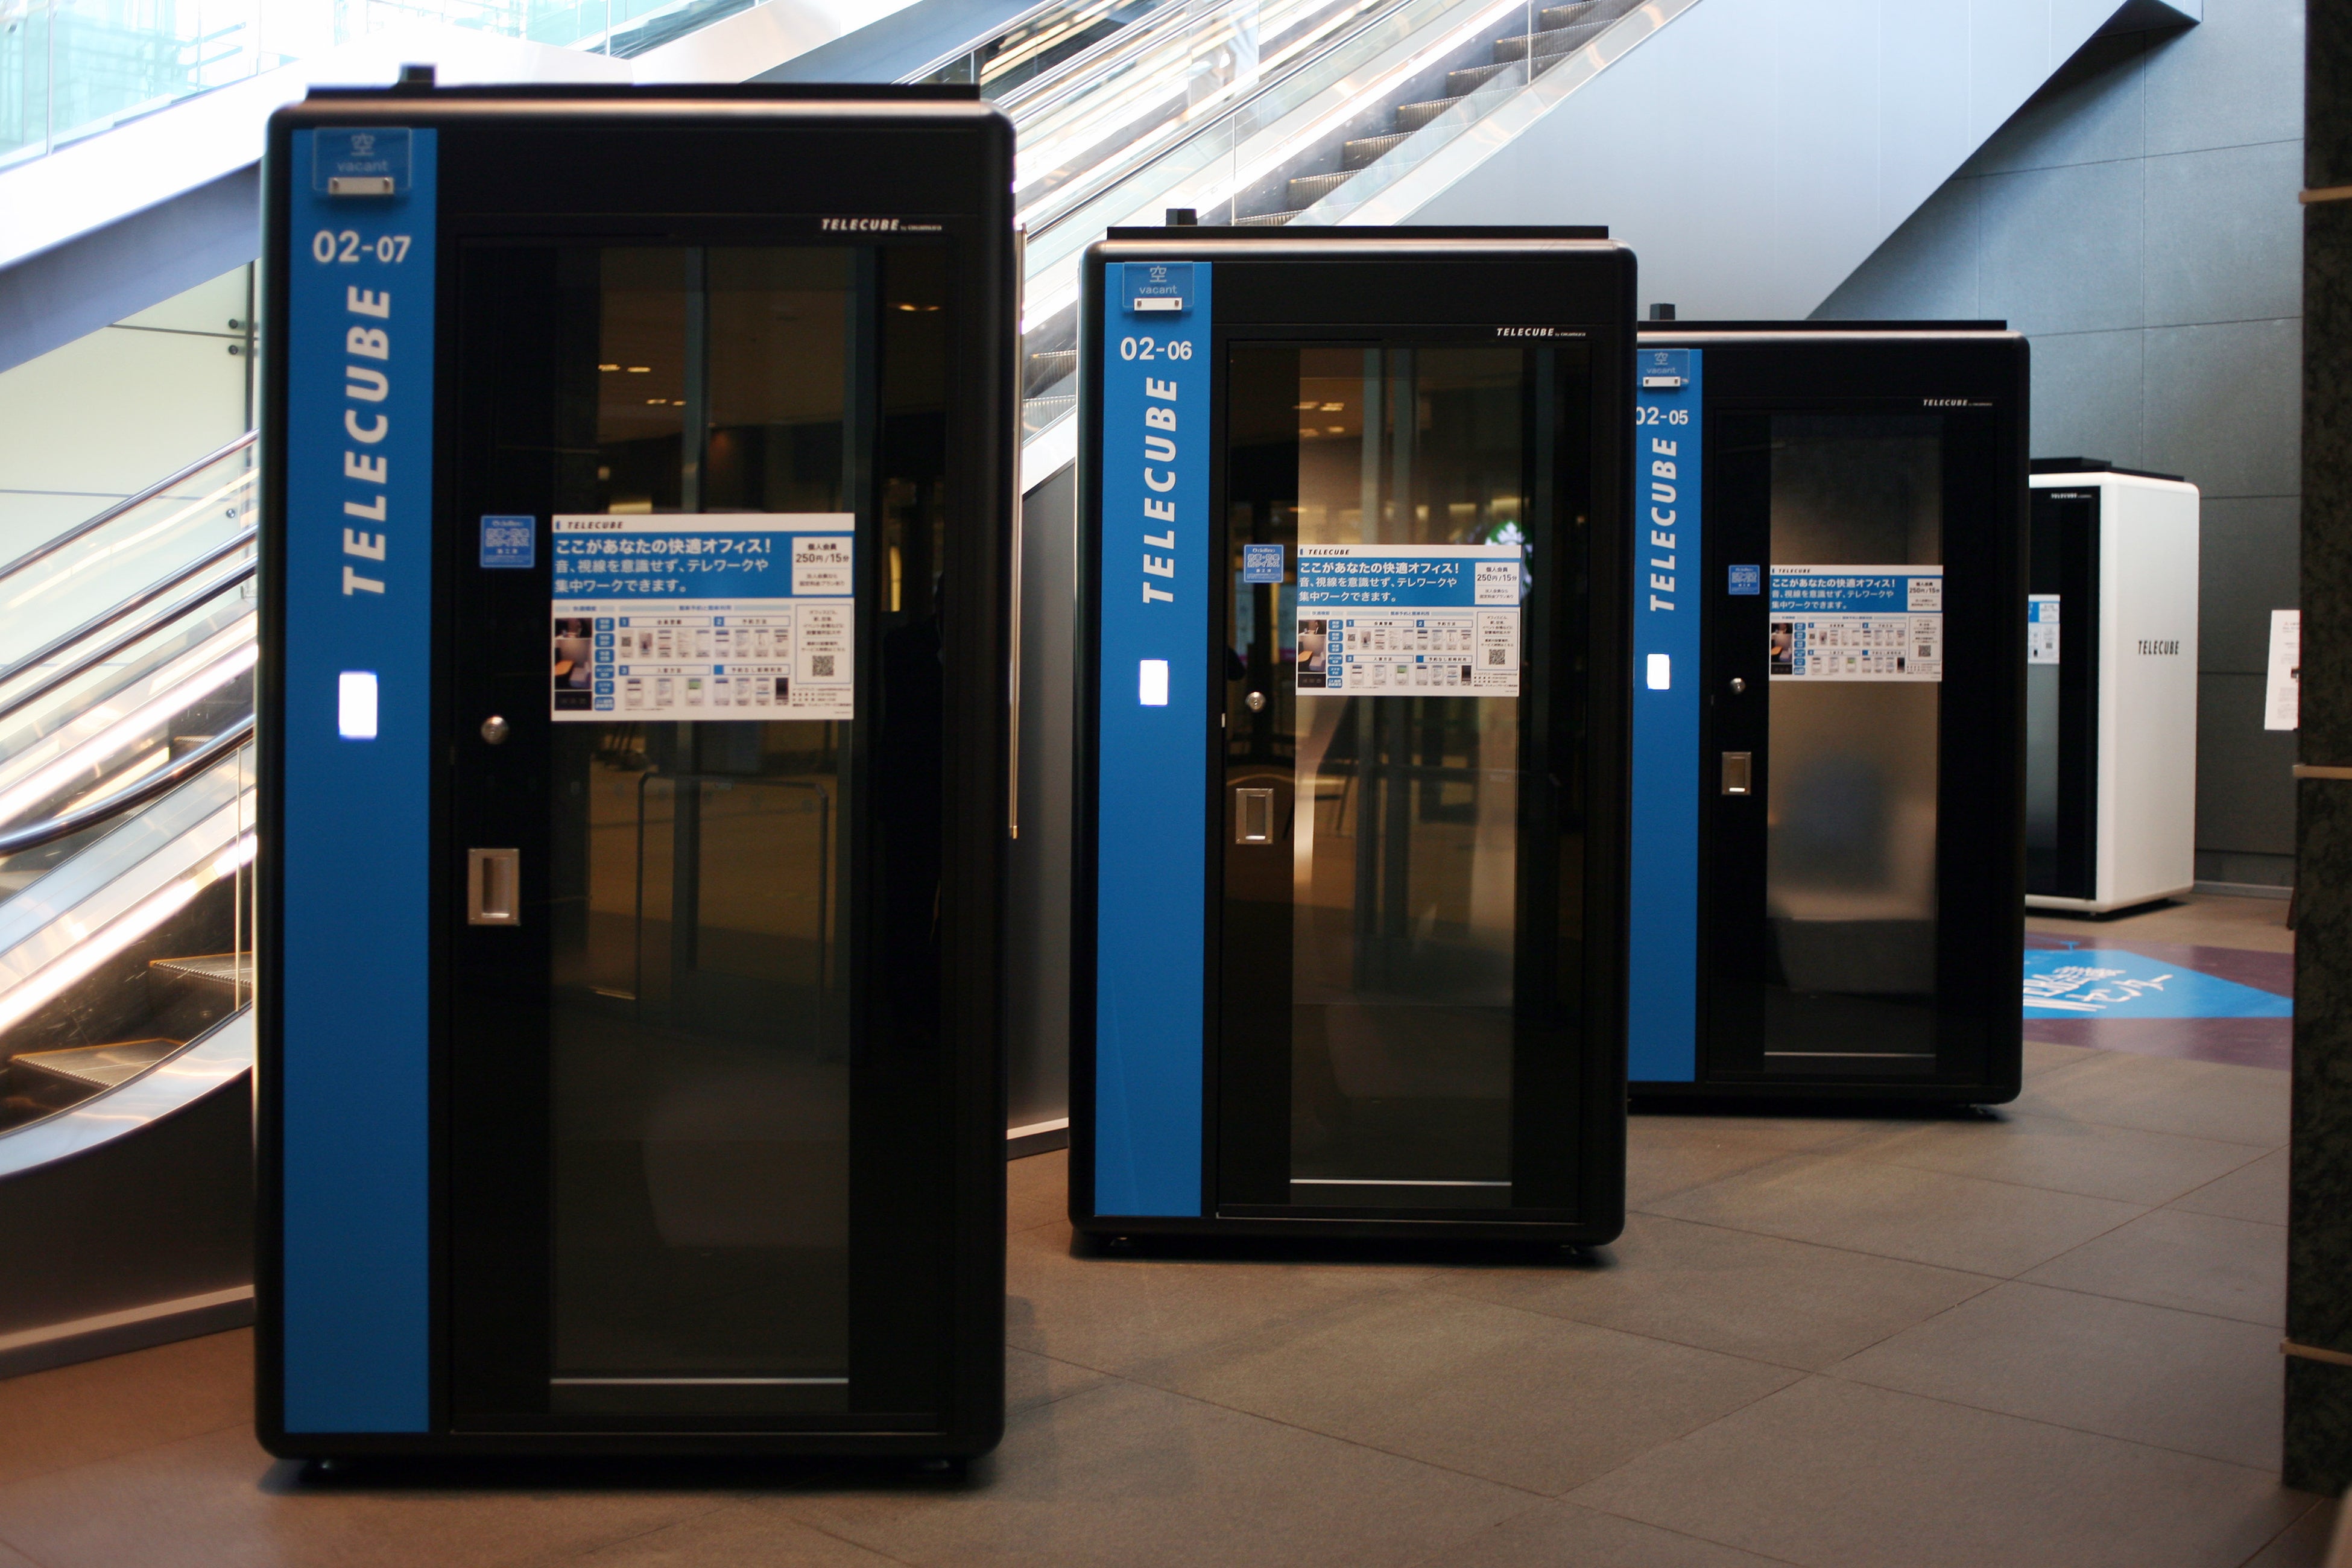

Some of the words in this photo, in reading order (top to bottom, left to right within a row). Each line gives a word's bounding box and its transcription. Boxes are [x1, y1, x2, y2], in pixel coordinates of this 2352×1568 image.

[337, 160, 388, 172] vacant
[821, 219, 900, 230] TELECUBE
[313, 230, 411, 263] 02-07
[1149, 266, 1167, 282] 空
[1139, 285, 1177, 294] vacant
[1121, 337, 1192, 361] 02-06
[1636, 406, 1689, 425] 02-05
[342, 285, 390, 596] TELECUBE
[1143, 377, 1177, 604] TELECUBE
[1650, 437, 1677, 612] TELECUBE
[2138, 640, 2180, 655] TELECUBE
